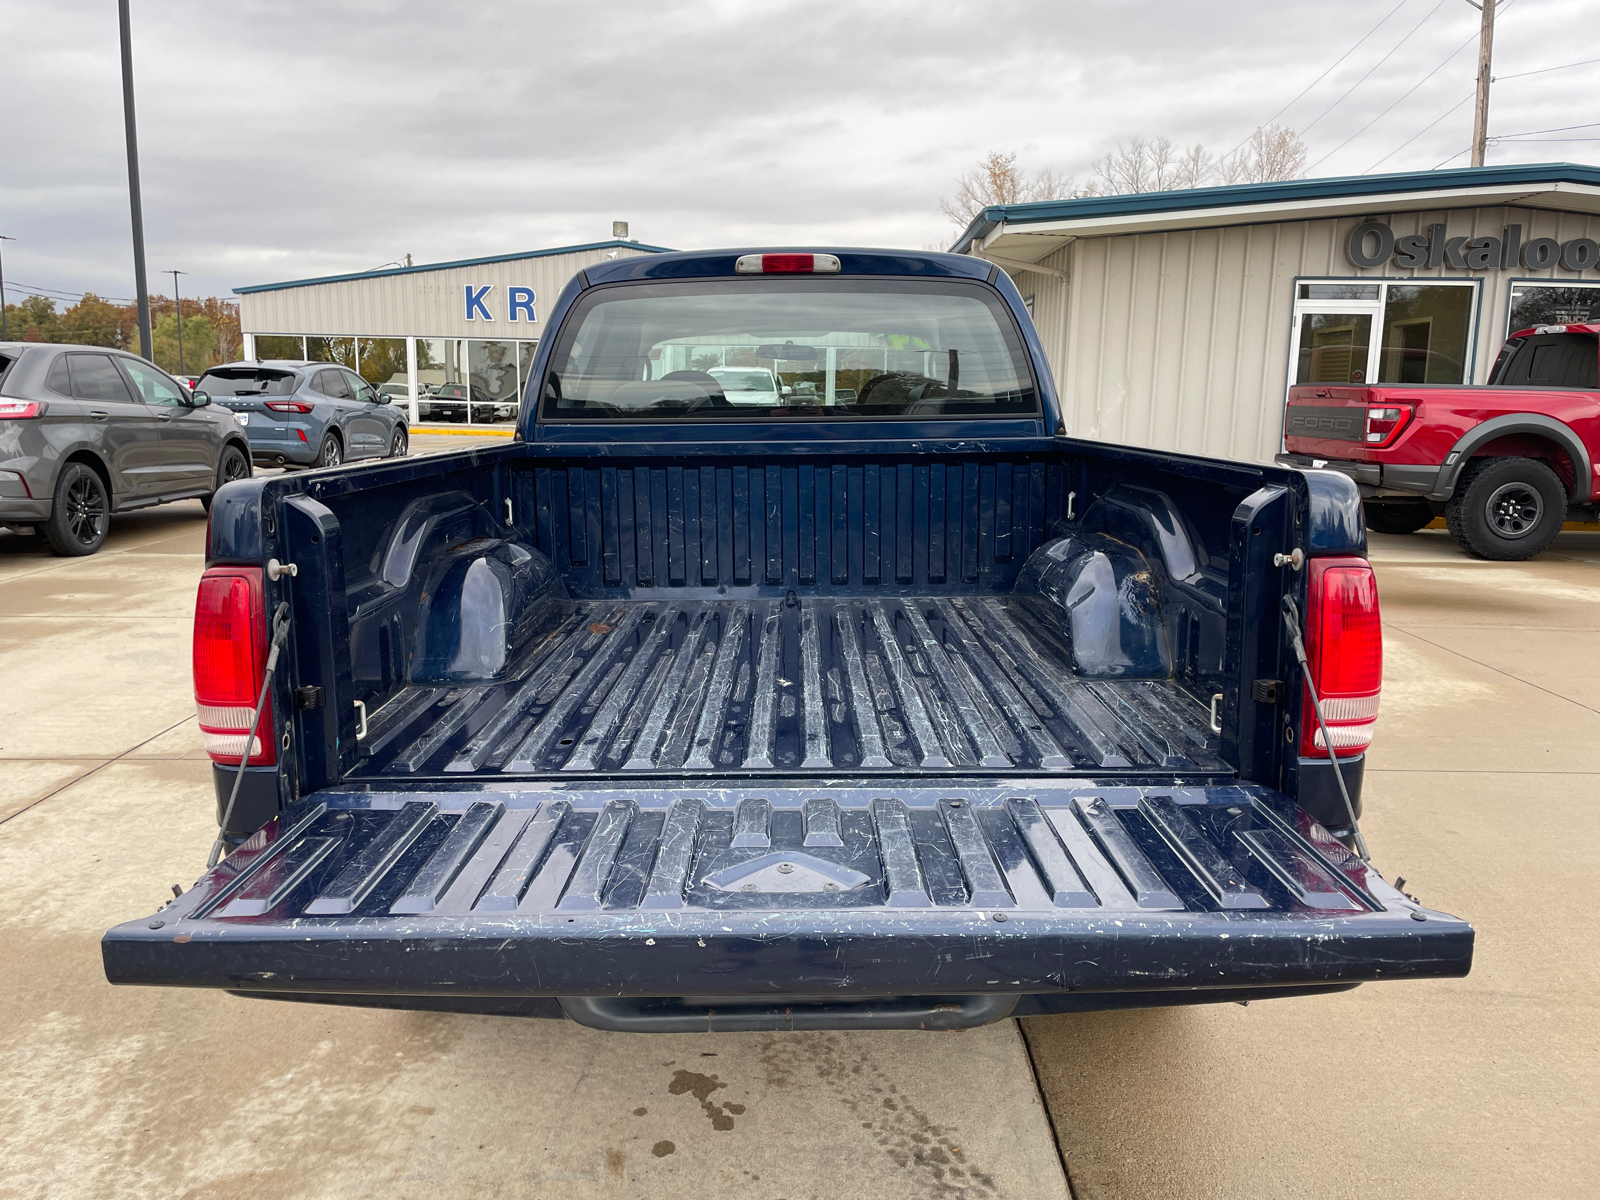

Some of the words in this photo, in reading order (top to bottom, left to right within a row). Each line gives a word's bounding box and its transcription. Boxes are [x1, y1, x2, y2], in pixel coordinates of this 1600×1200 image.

[1346, 221, 1600, 270] Oskaloo
[464, 284, 540, 323] KR
[1555, 315, 1589, 324] TRUCK
[1292, 416, 1353, 430] FORD
